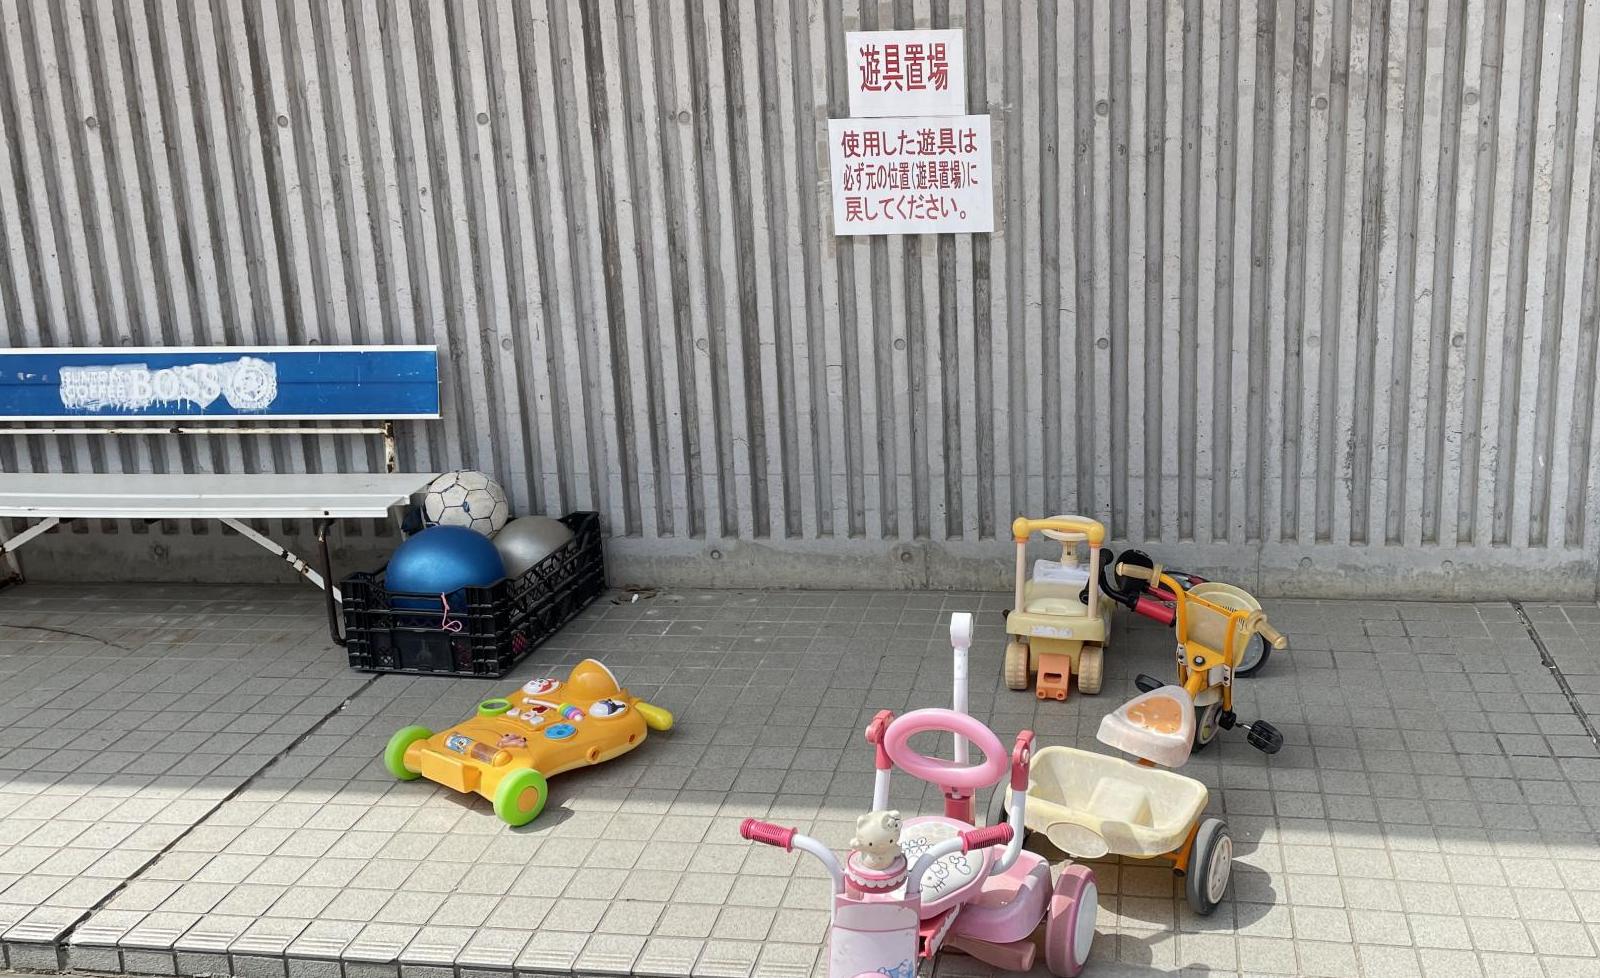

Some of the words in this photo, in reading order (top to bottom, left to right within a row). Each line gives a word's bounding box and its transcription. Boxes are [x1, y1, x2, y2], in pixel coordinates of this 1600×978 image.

[859, 43, 949, 92] 遊具置場
[841, 127, 978, 158] 使用した遊具は
[845, 194, 967, 222] 戻してください。
[129, 366, 221, 401] BOSS
